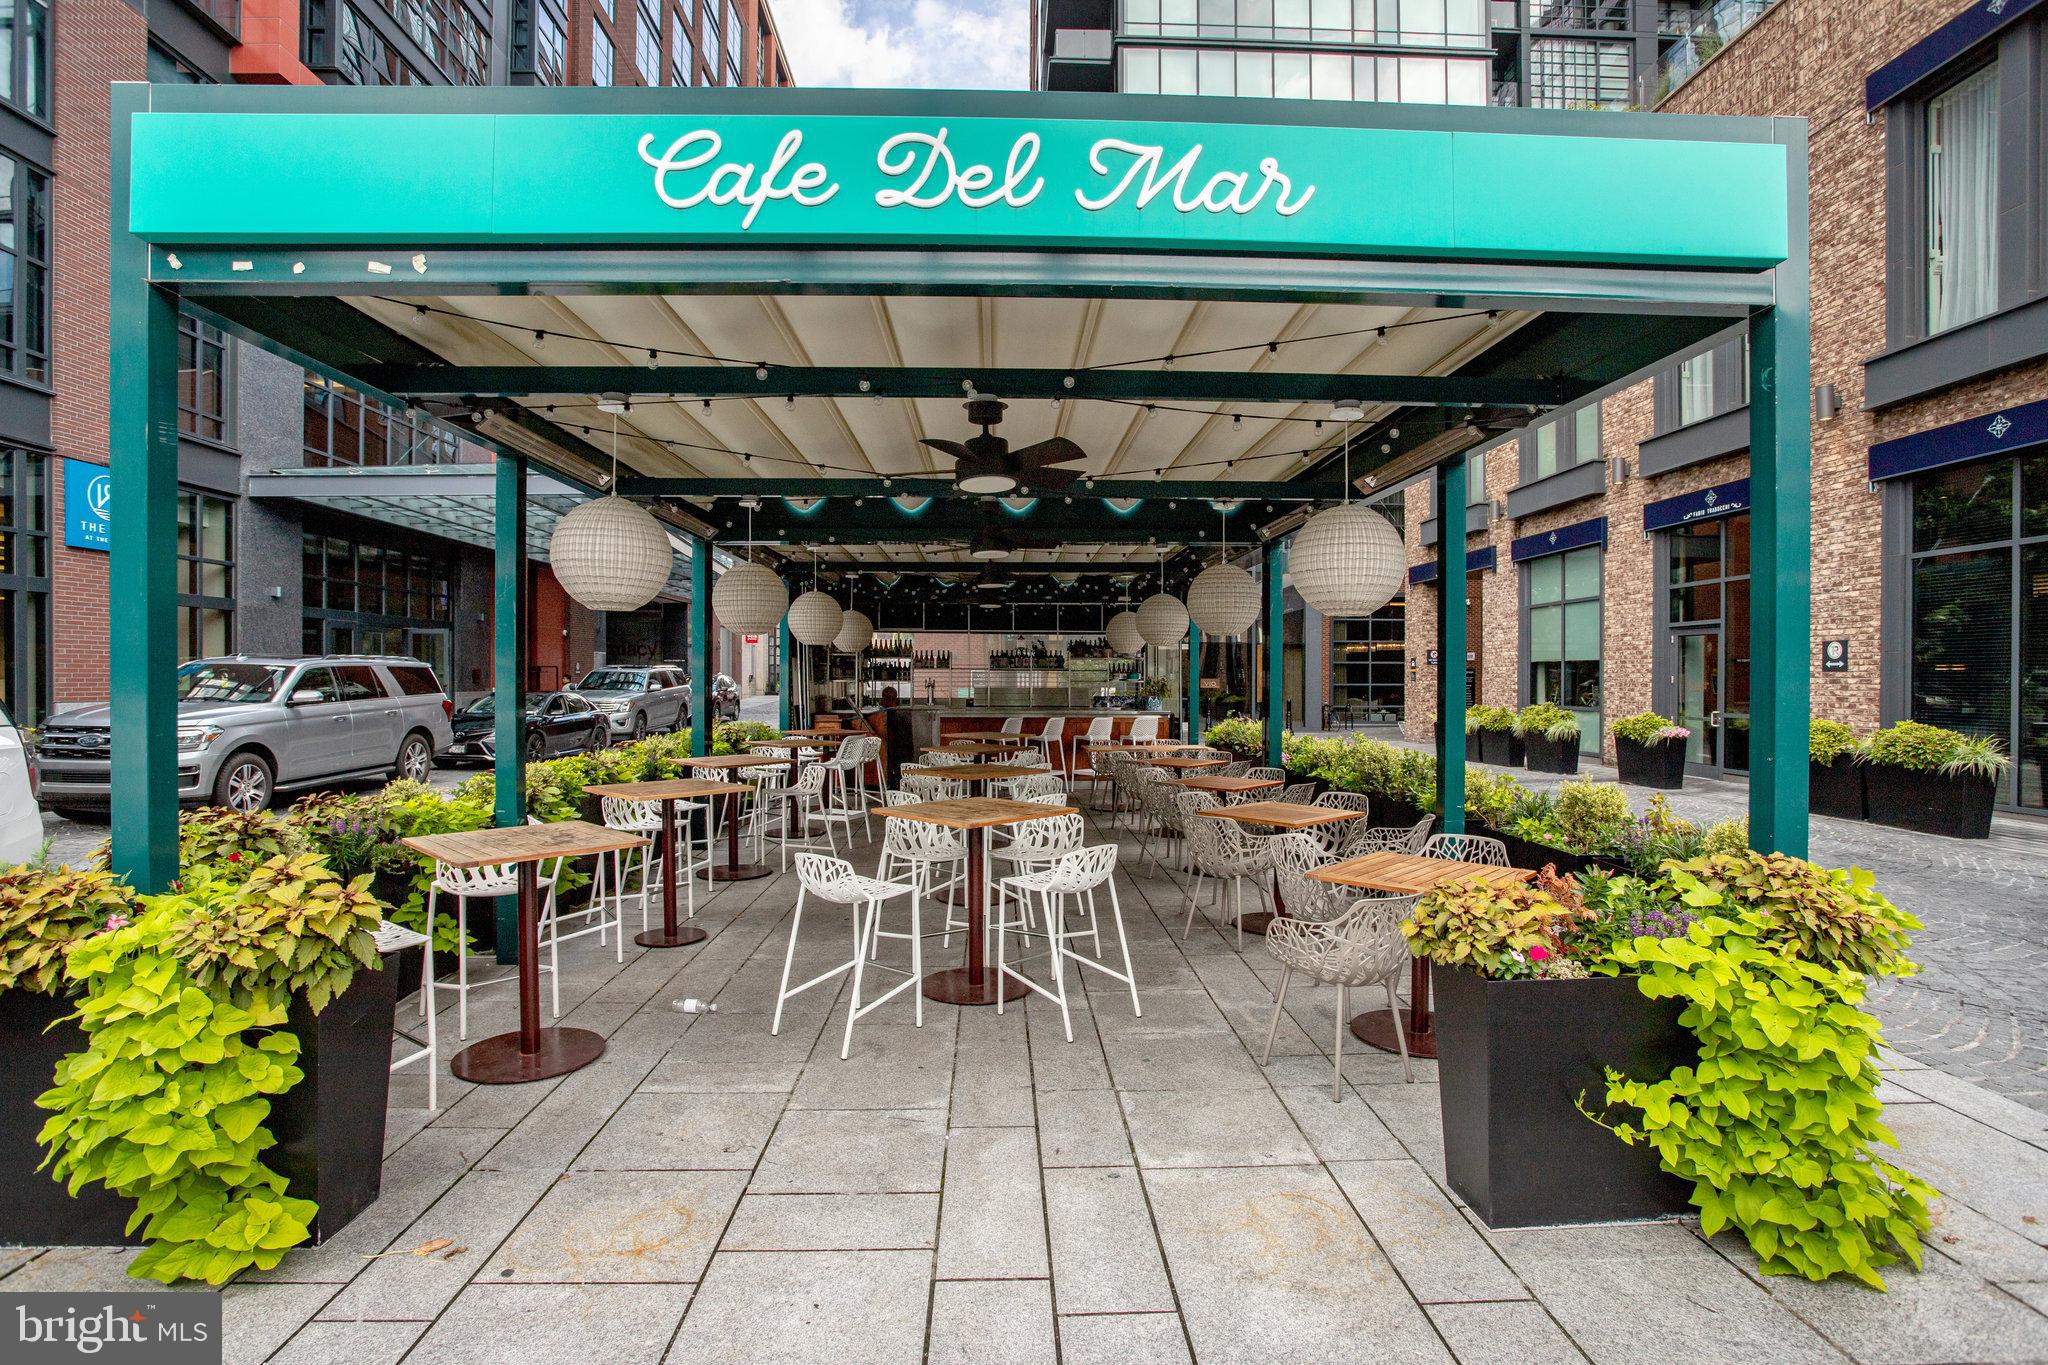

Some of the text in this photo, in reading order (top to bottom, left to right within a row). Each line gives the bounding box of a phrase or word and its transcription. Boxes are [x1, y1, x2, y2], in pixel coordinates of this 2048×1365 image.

[638, 128, 1316, 229] Cafe Del Mar
[81, 520, 106, 534] THE
